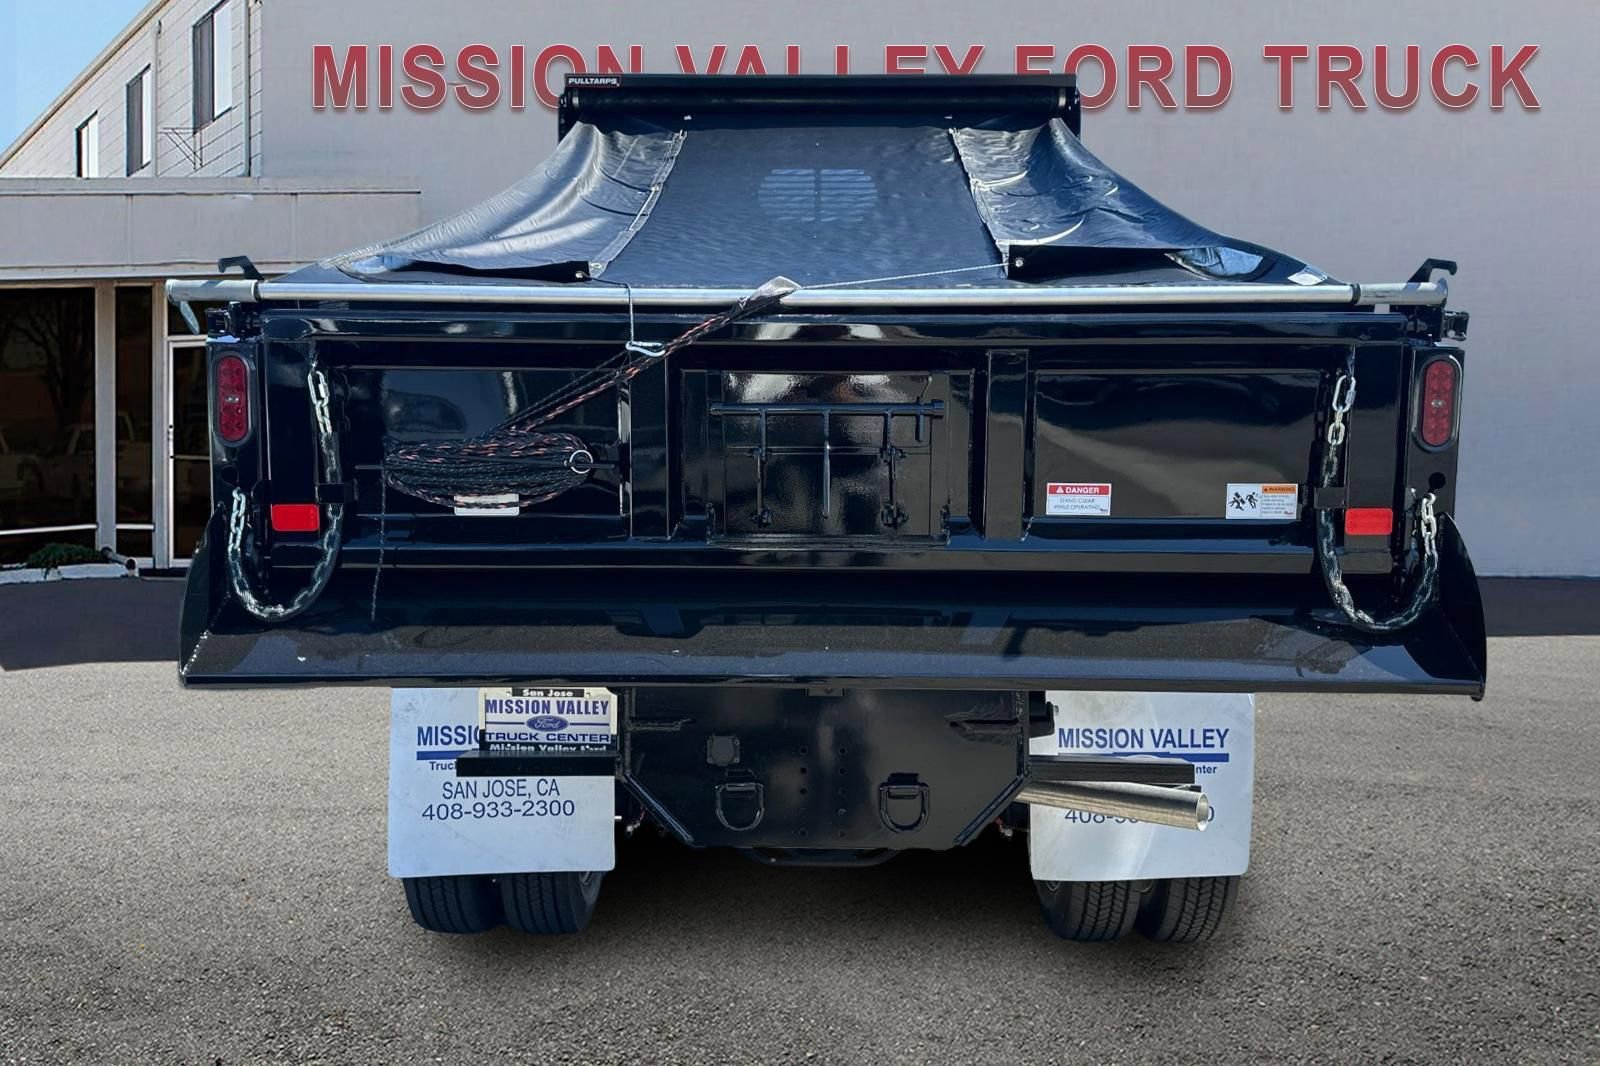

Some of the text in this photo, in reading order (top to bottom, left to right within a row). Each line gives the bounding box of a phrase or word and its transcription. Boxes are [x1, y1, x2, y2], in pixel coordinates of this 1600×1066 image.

[568, 77, 618, 85] PULLTARPS
[1015, 44, 1233, 108] FORD
[1263, 44, 1542, 108] TRUCK
[1065, 486, 1100, 494] DANGER
[522, 689, 574, 697] San Jose
[485, 699, 609, 715] MISSION VALLEY
[534, 718, 560, 729] Ford
[417, 725, 480, 746] MISSI
[485, 732, 610, 742] TRUCK CENTER
[1058, 728, 1230, 749] MISSION VALLEY
[429, 761, 457, 771] Truc
[1195, 764, 1218, 774] nter
[442, 778, 560, 800] SAN JOSE, CA
[422, 799, 575, 821] 408-933-2300
